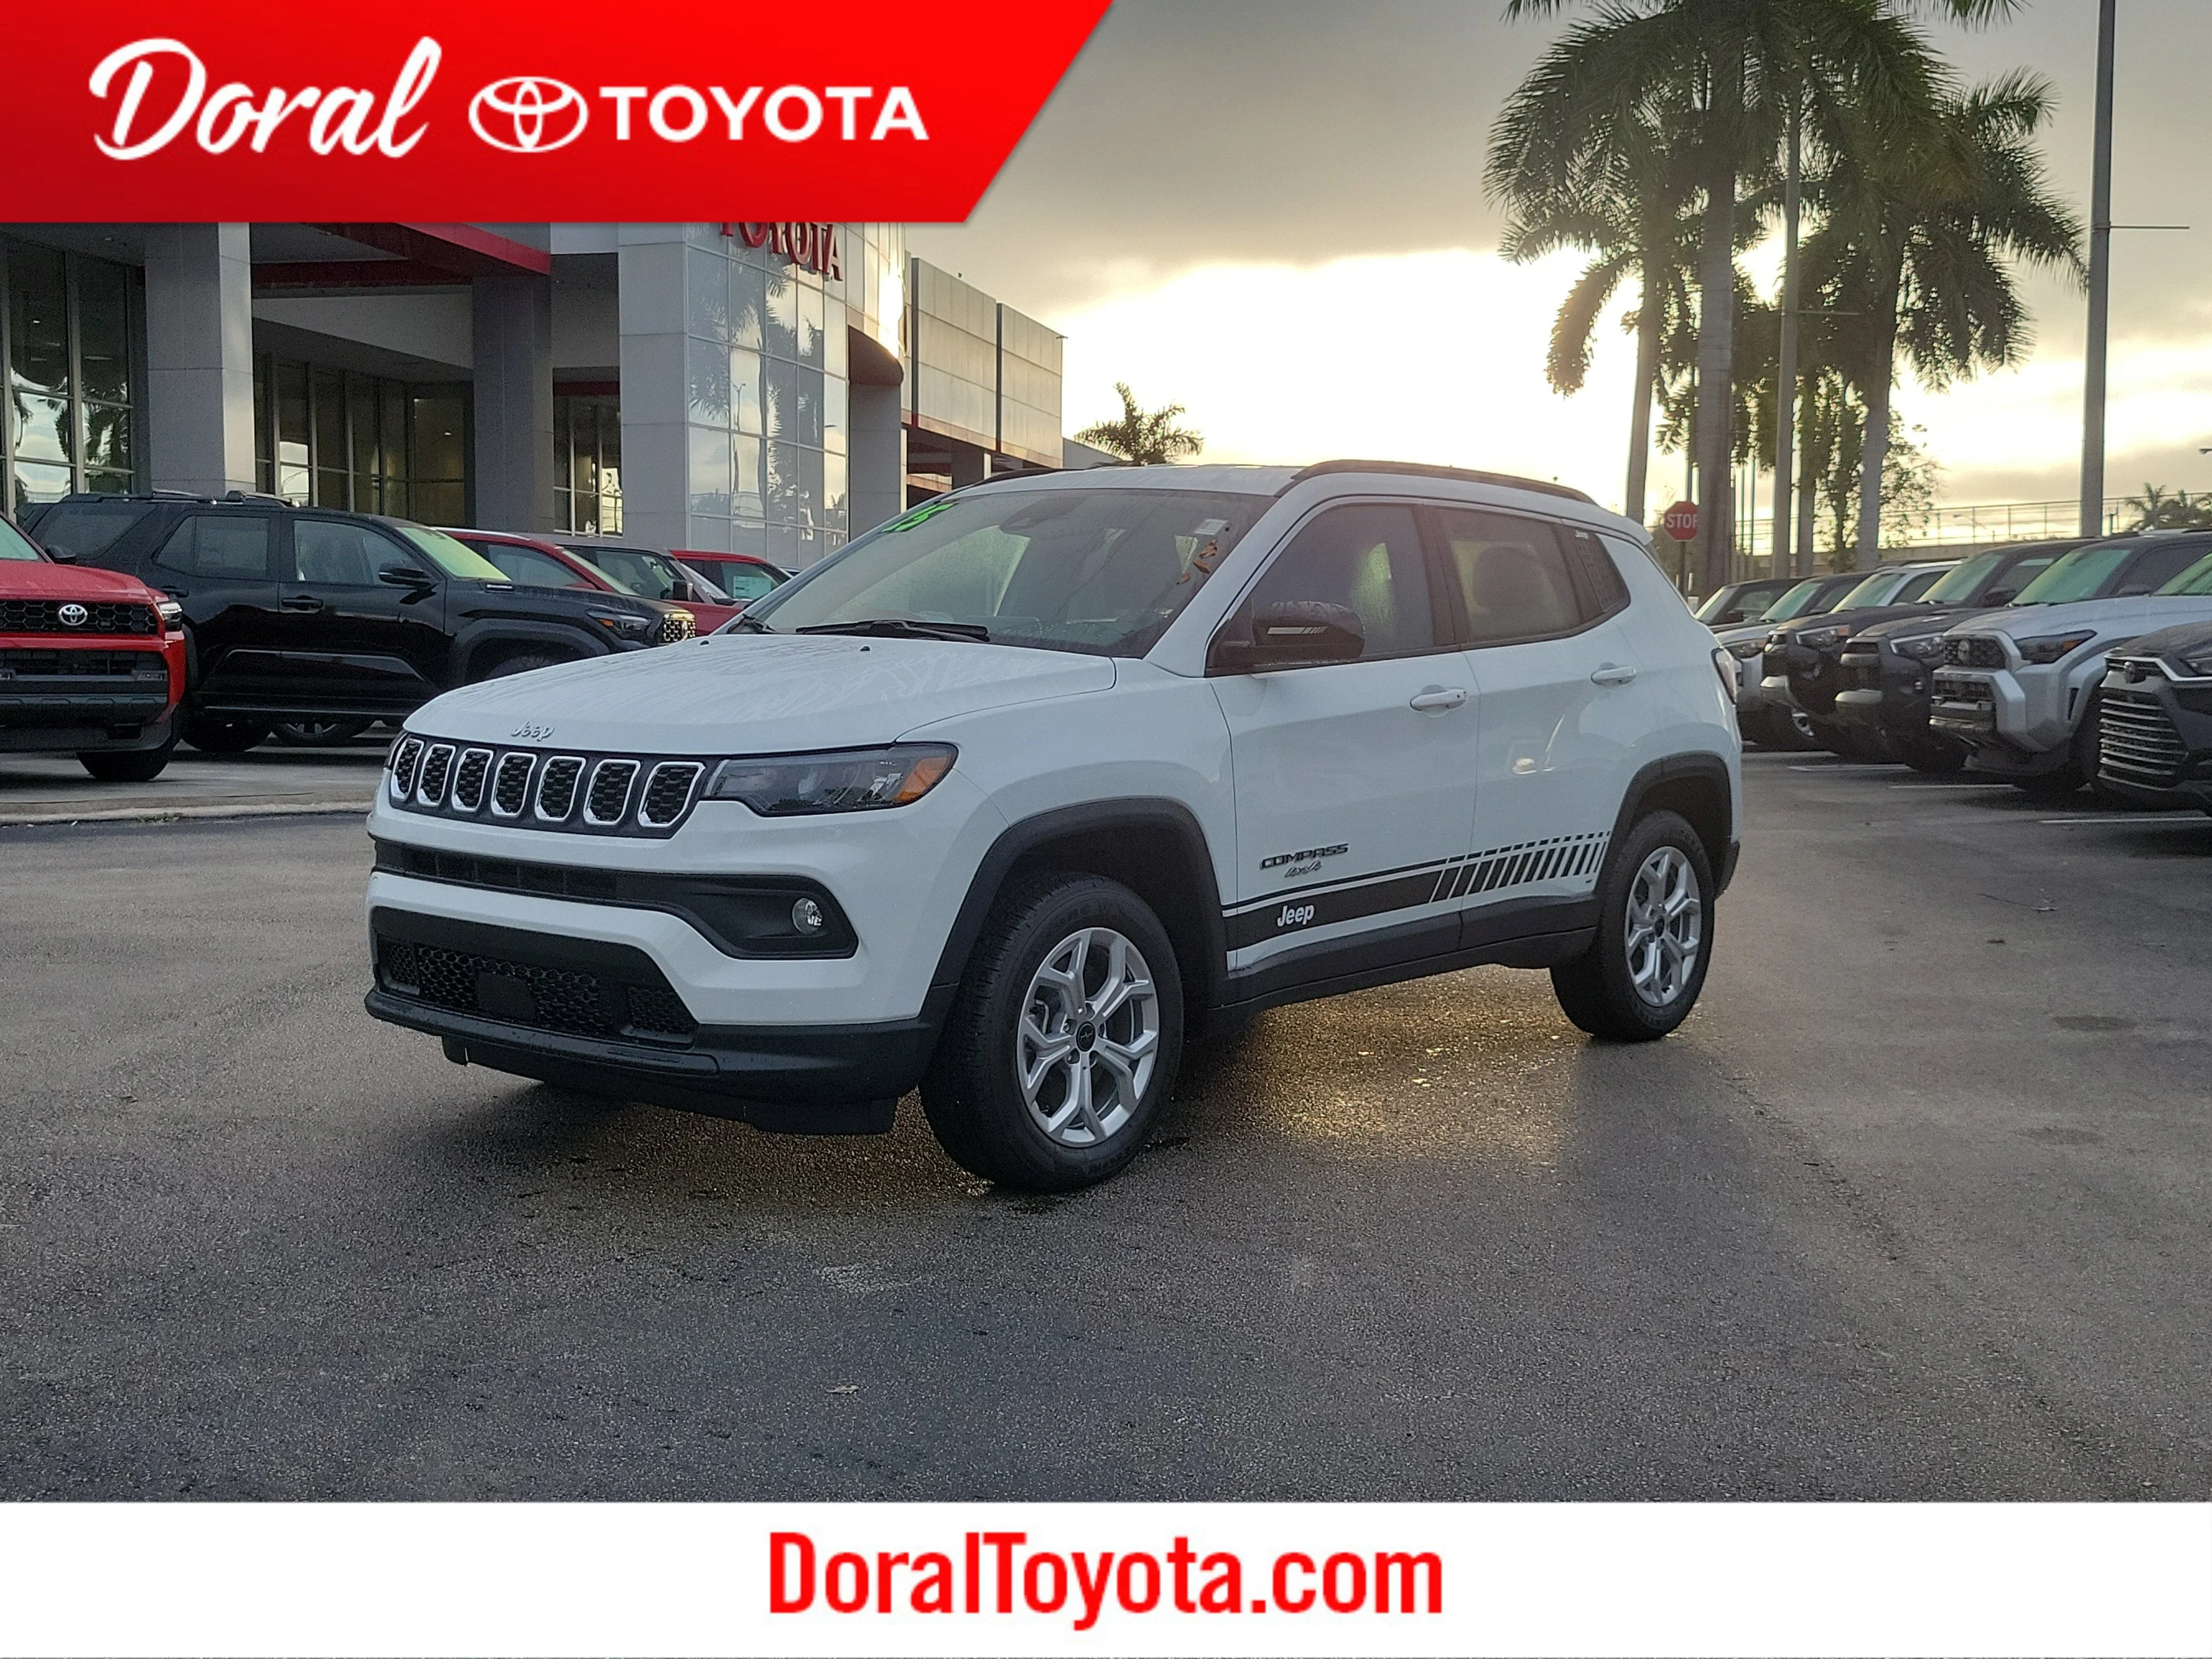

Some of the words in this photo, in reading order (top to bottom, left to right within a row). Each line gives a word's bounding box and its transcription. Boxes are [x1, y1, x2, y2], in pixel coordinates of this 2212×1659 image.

[511, 720, 555, 741] Jeep
[1260, 843, 1348, 870] COMPASS
[1277, 905, 1314, 927] Jeep
